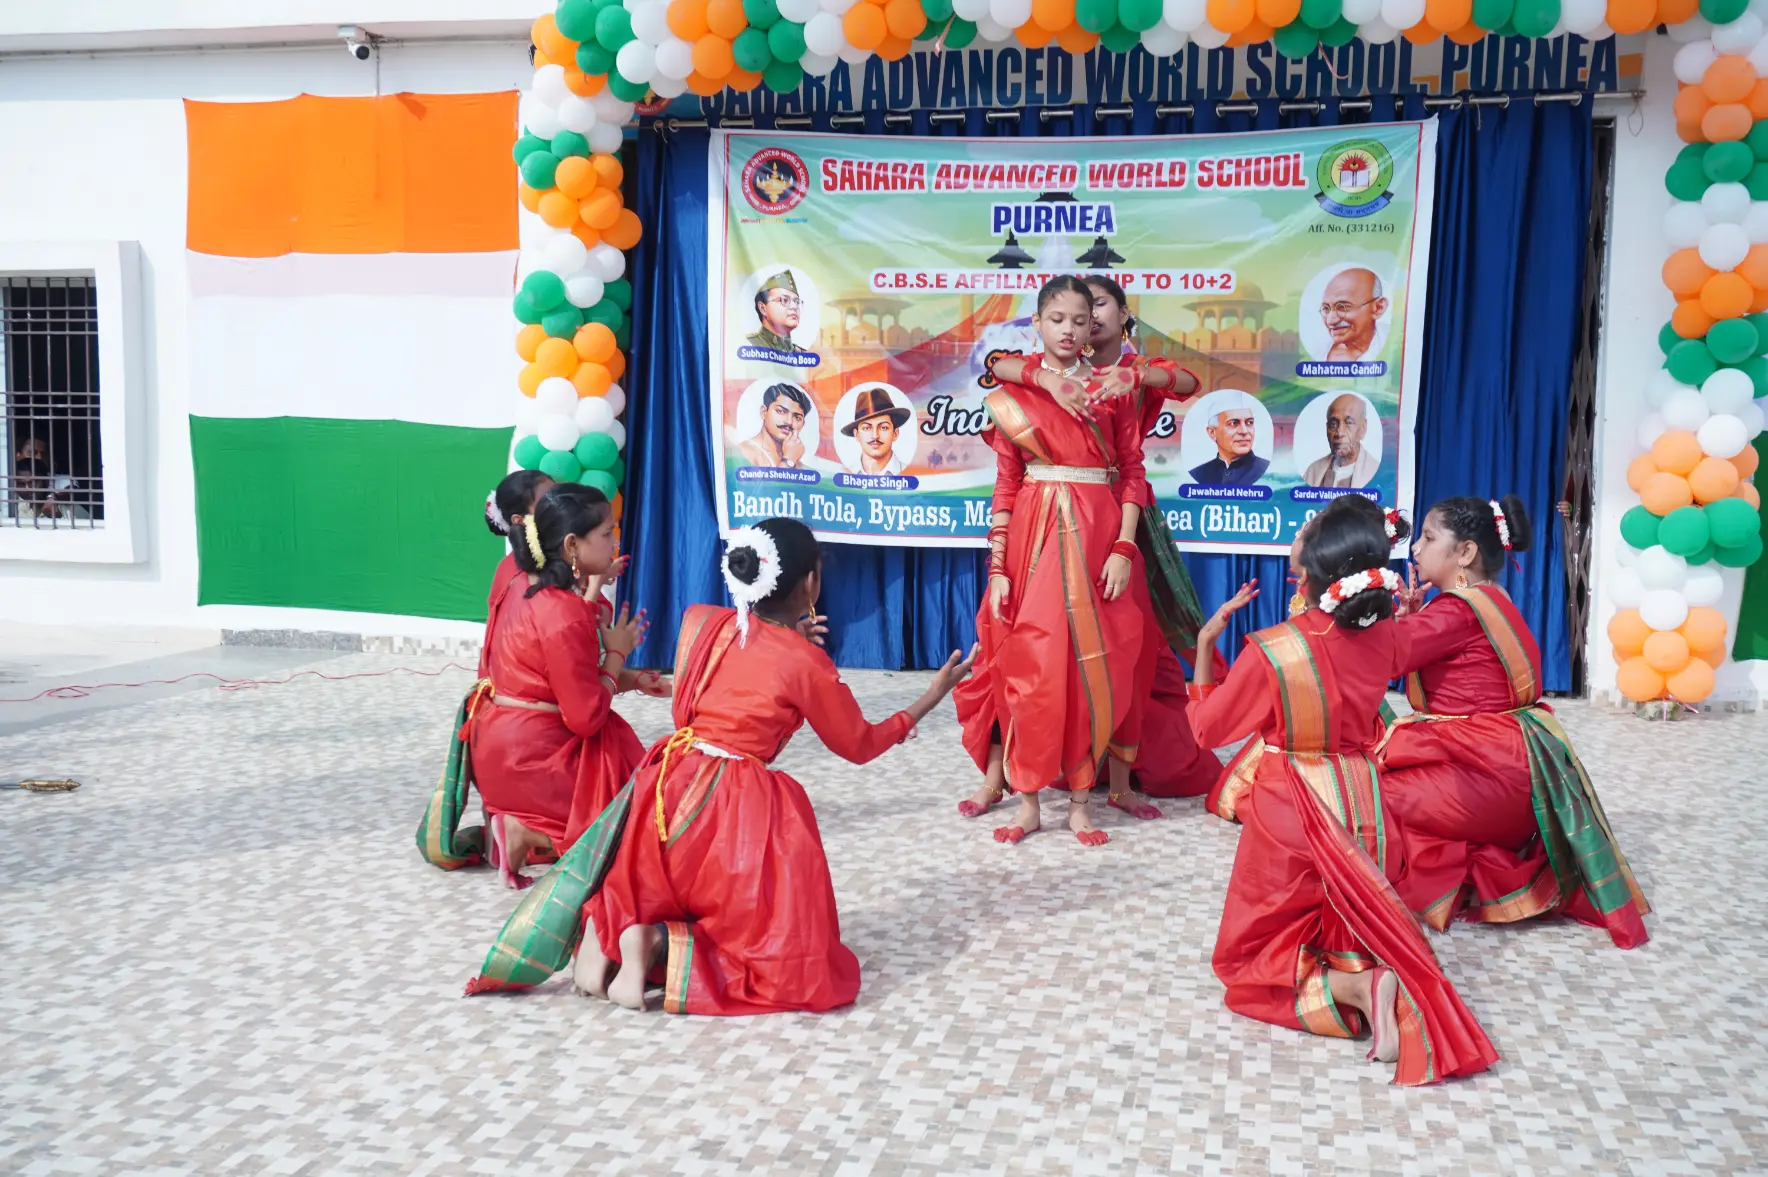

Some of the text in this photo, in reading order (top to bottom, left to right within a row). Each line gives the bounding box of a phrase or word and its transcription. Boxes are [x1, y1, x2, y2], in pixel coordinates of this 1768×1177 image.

[861, 47, 1073, 111] ADVANCED
[1084, 41, 1235, 102] WORLD
[1440, 32, 1617, 95] PURNEA
[822, 158, 926, 191] SAHARA
[934, 163, 1077, 190] ADVANCED
[1089, 161, 1187, 188] WORLD
[1197, 153, 1306, 187] SCHOOL
[993, 205, 1114, 233] PURNEA
[1308, 223, 1395, 235] Aff. No. (331216)
[874, 273, 948, 289] C.B.S.E
[954, 273, 1089, 289] AFFILIAT
[1142, 273, 1172, 289] TO
[1180, 273, 1232, 290] 10+2
[741, 348, 817, 365] Subhas Chandra Bose
[1302, 363, 1382, 375] Mahatma Gandhi
[739, 469, 816, 482] Chandra Shekhar Azad
[842, 475, 909, 490] Bhagat Singh
[1187, 487, 1264, 498] Jawaharlal Nehru
[1294, 490, 1318, 499] Sardar
[733, 490, 803, 518] Bandh
[809, 494, 862, 530] Tola,
[868, 498, 957, 533] Bypass,
[1200, 504, 1282, 540] (Bihar)
